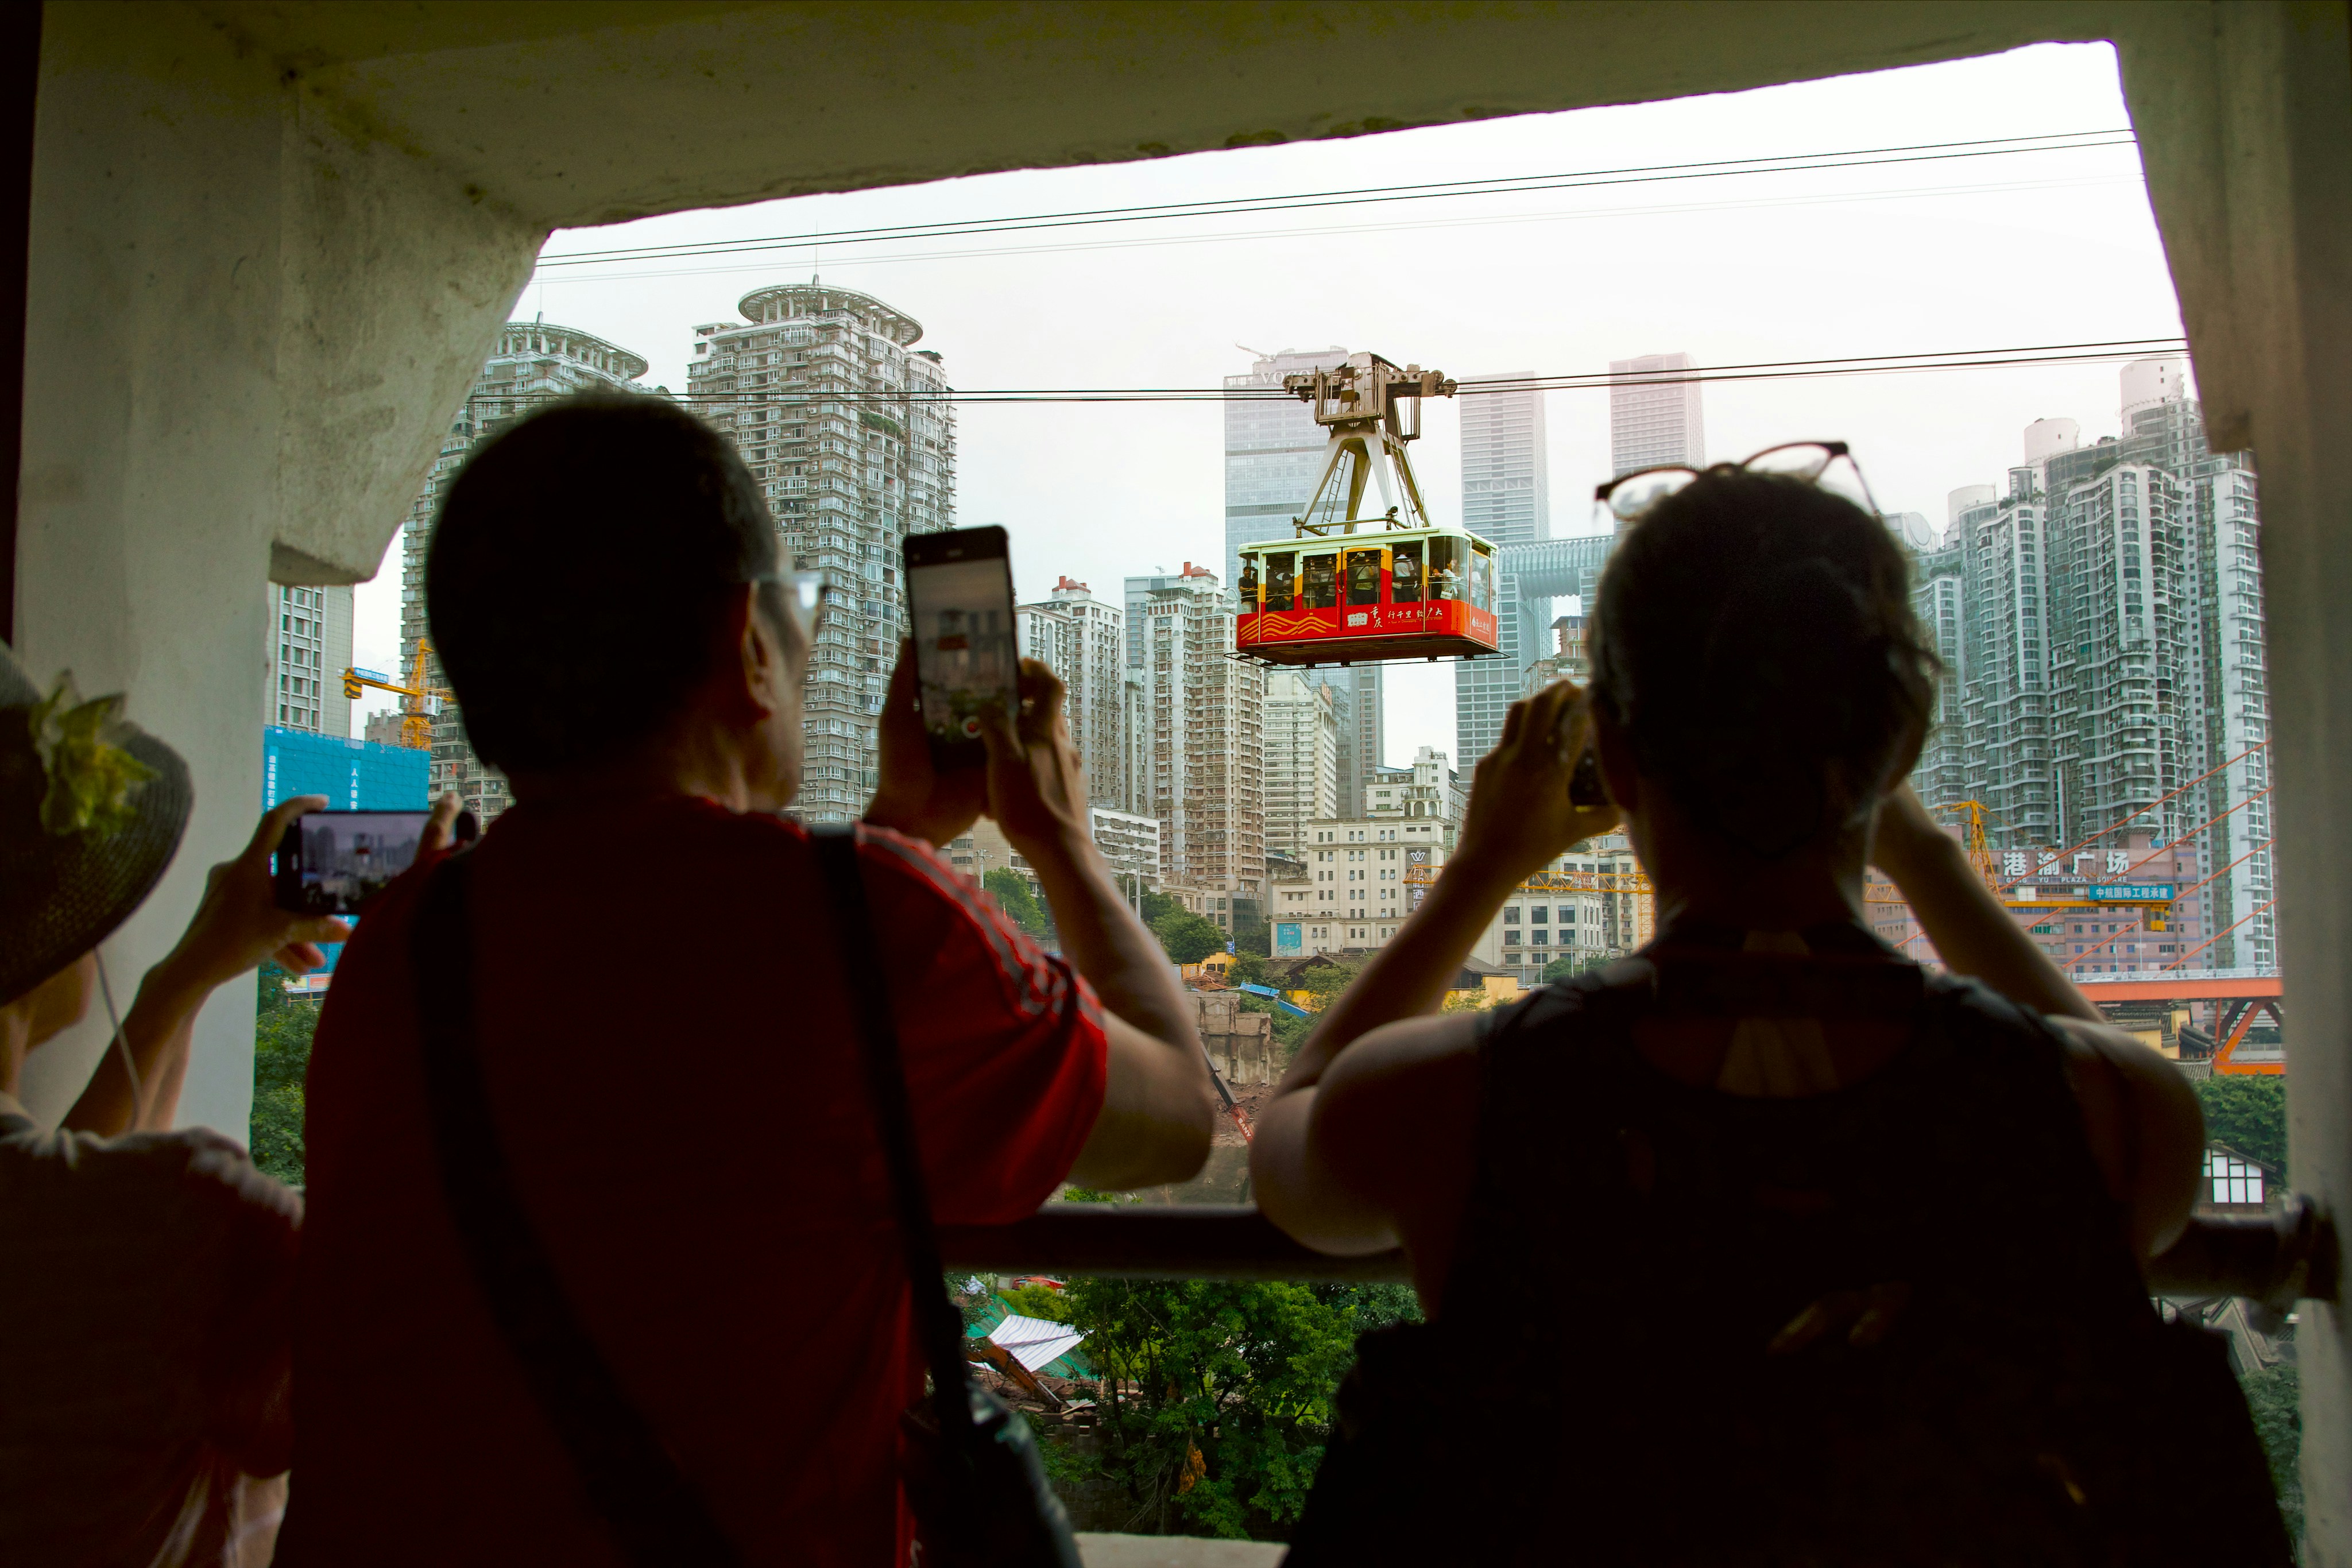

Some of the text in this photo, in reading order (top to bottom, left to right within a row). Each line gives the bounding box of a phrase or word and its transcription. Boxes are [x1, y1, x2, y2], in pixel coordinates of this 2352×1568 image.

[1370, 606, 1383, 628] 重庆
[2003, 851, 2129, 876] 港渝广场
[1237, 1117, 1252, 1137] SANY
